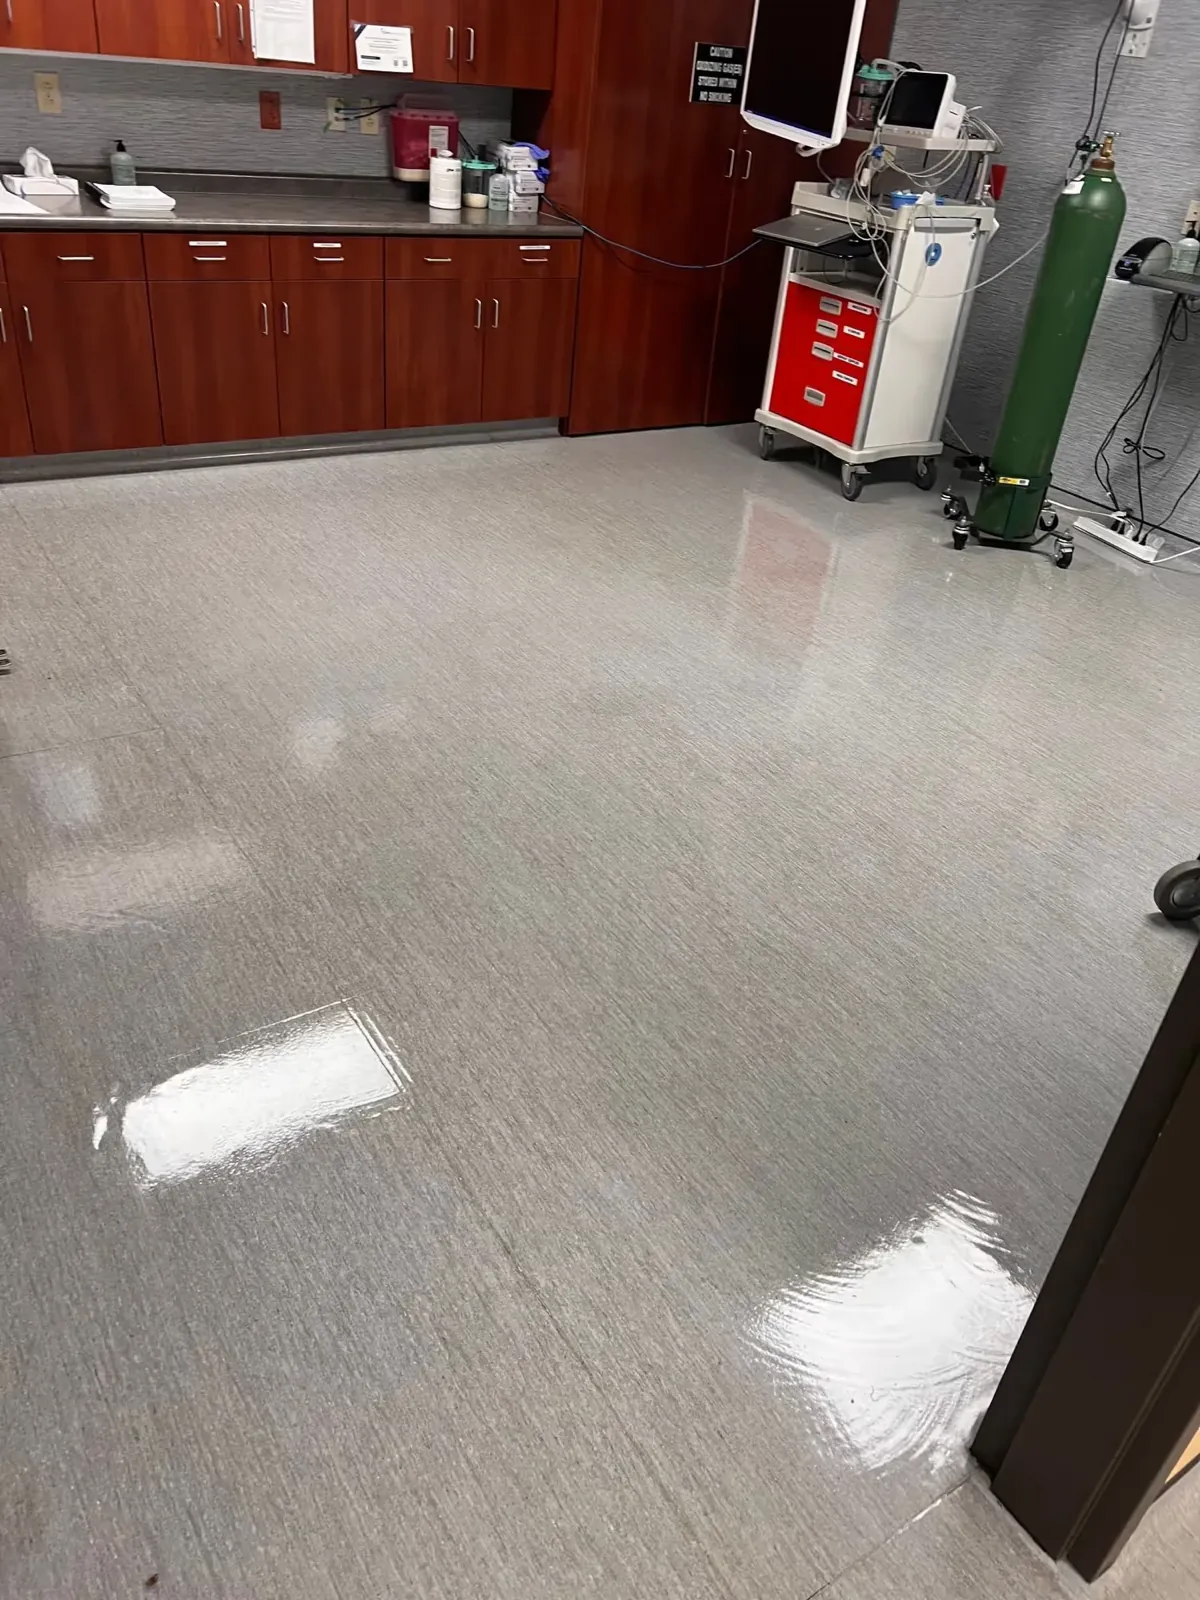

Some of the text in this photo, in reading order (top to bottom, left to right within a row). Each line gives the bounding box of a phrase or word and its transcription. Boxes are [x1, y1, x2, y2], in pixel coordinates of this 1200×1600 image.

[709, 46, 734, 58] CAUTION
[699, 90, 732, 102] NO SMOKING
